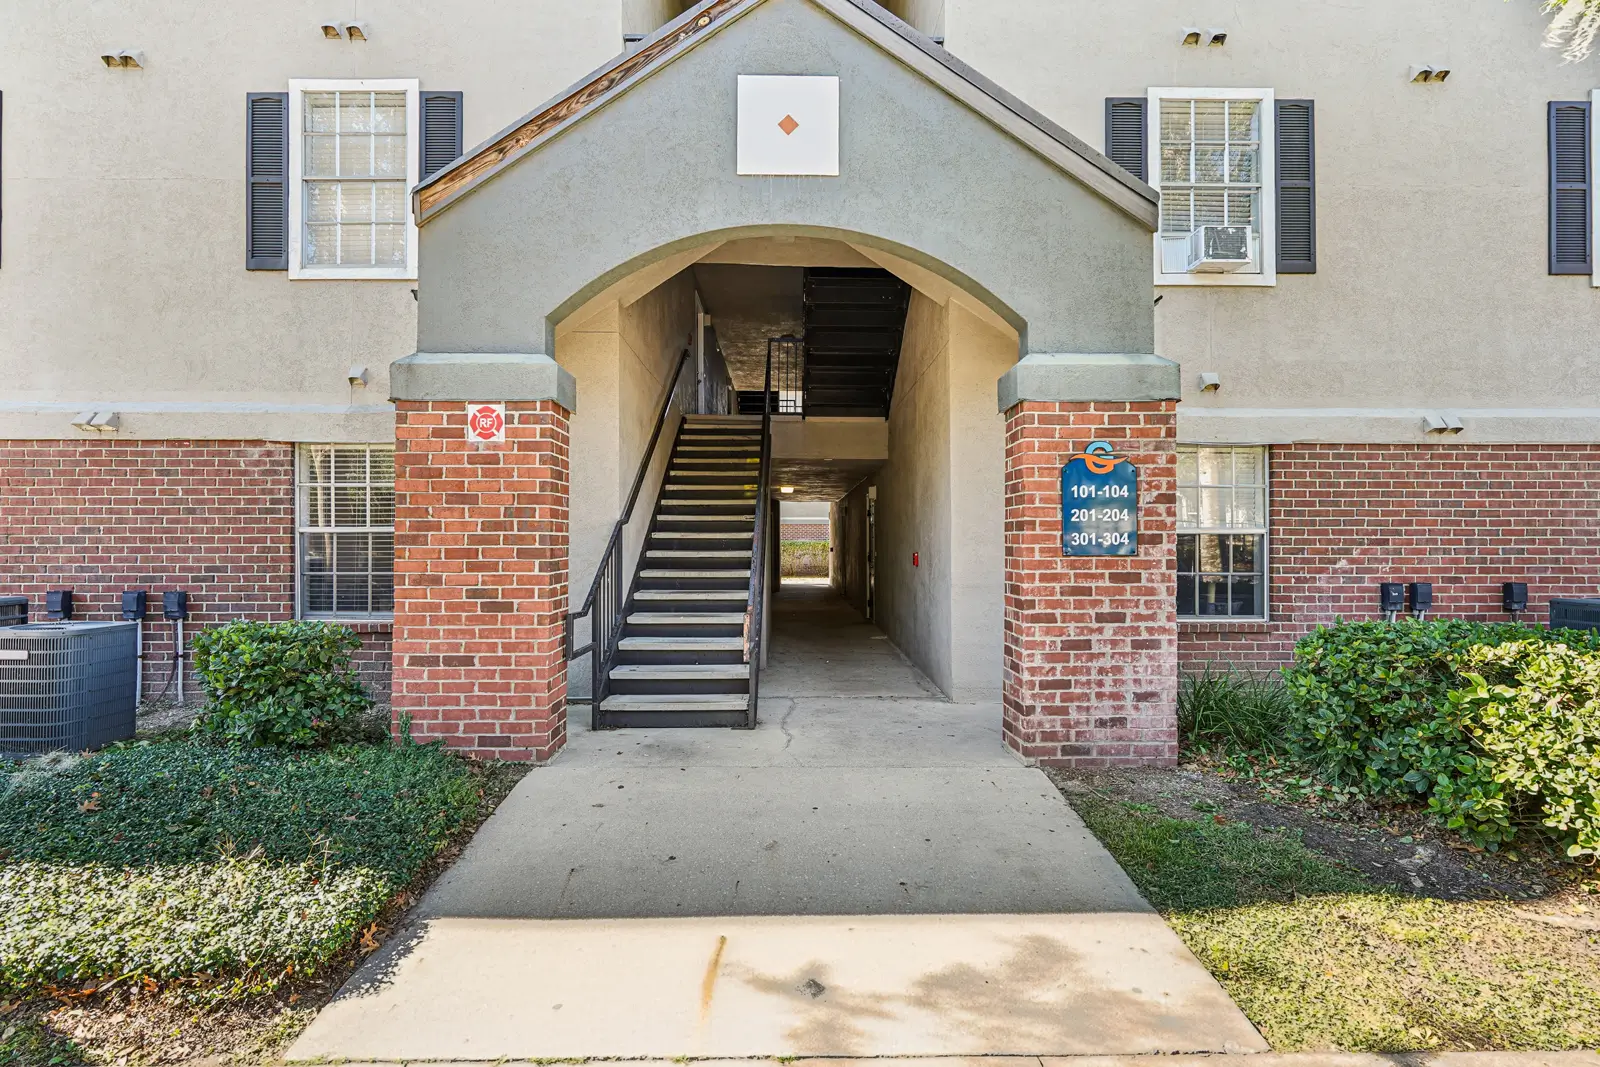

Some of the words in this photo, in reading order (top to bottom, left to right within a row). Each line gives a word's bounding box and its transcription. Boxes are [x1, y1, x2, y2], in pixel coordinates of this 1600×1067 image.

[480, 418, 493, 428] RF
[1071, 485, 1129, 498] 101-104
[1070, 508, 1129, 522] 201-204
[1071, 532, 1130, 545] 301-304
